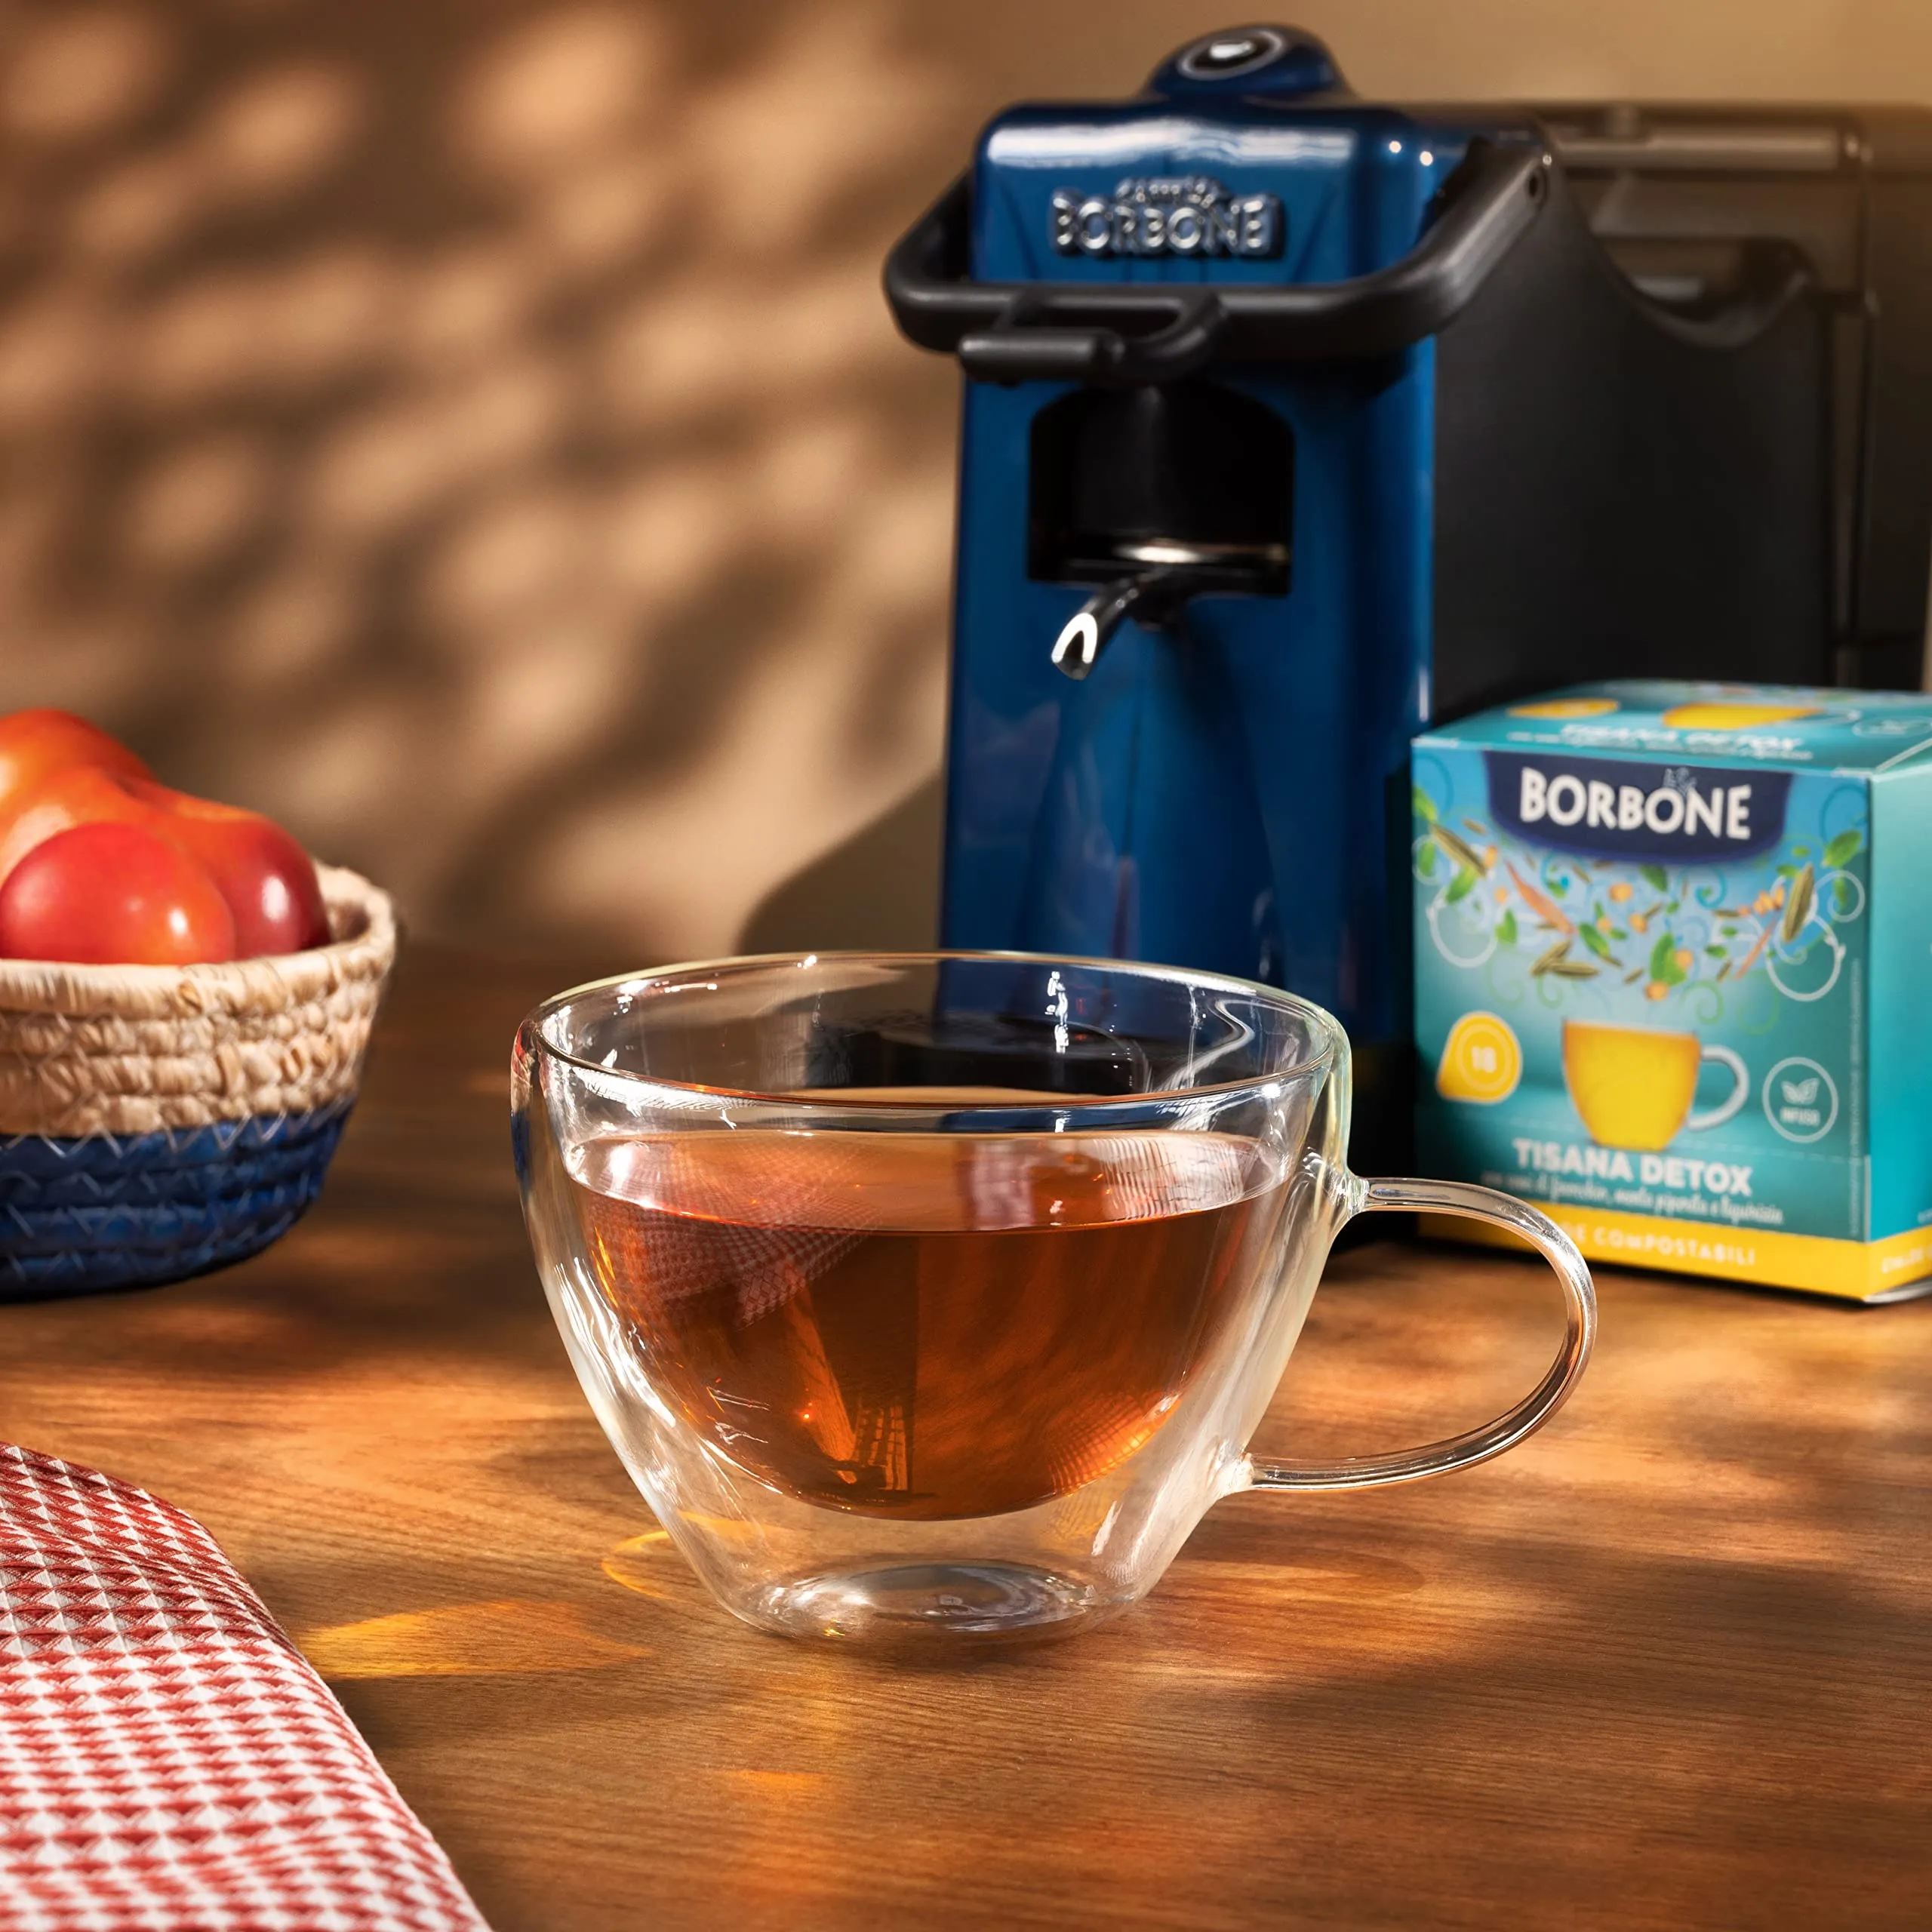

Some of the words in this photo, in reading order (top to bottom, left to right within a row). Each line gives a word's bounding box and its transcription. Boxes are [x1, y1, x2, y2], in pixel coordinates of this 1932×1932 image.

[1050, 189, 1280, 257] BORBONE
[1519, 766, 1752, 840] BORBONE
[1512, 1137, 1633, 1182] TISANA
[1639, 1153, 1753, 1197] DETOX
[1593, 1225, 1755, 1266] COMPOSTABILI
